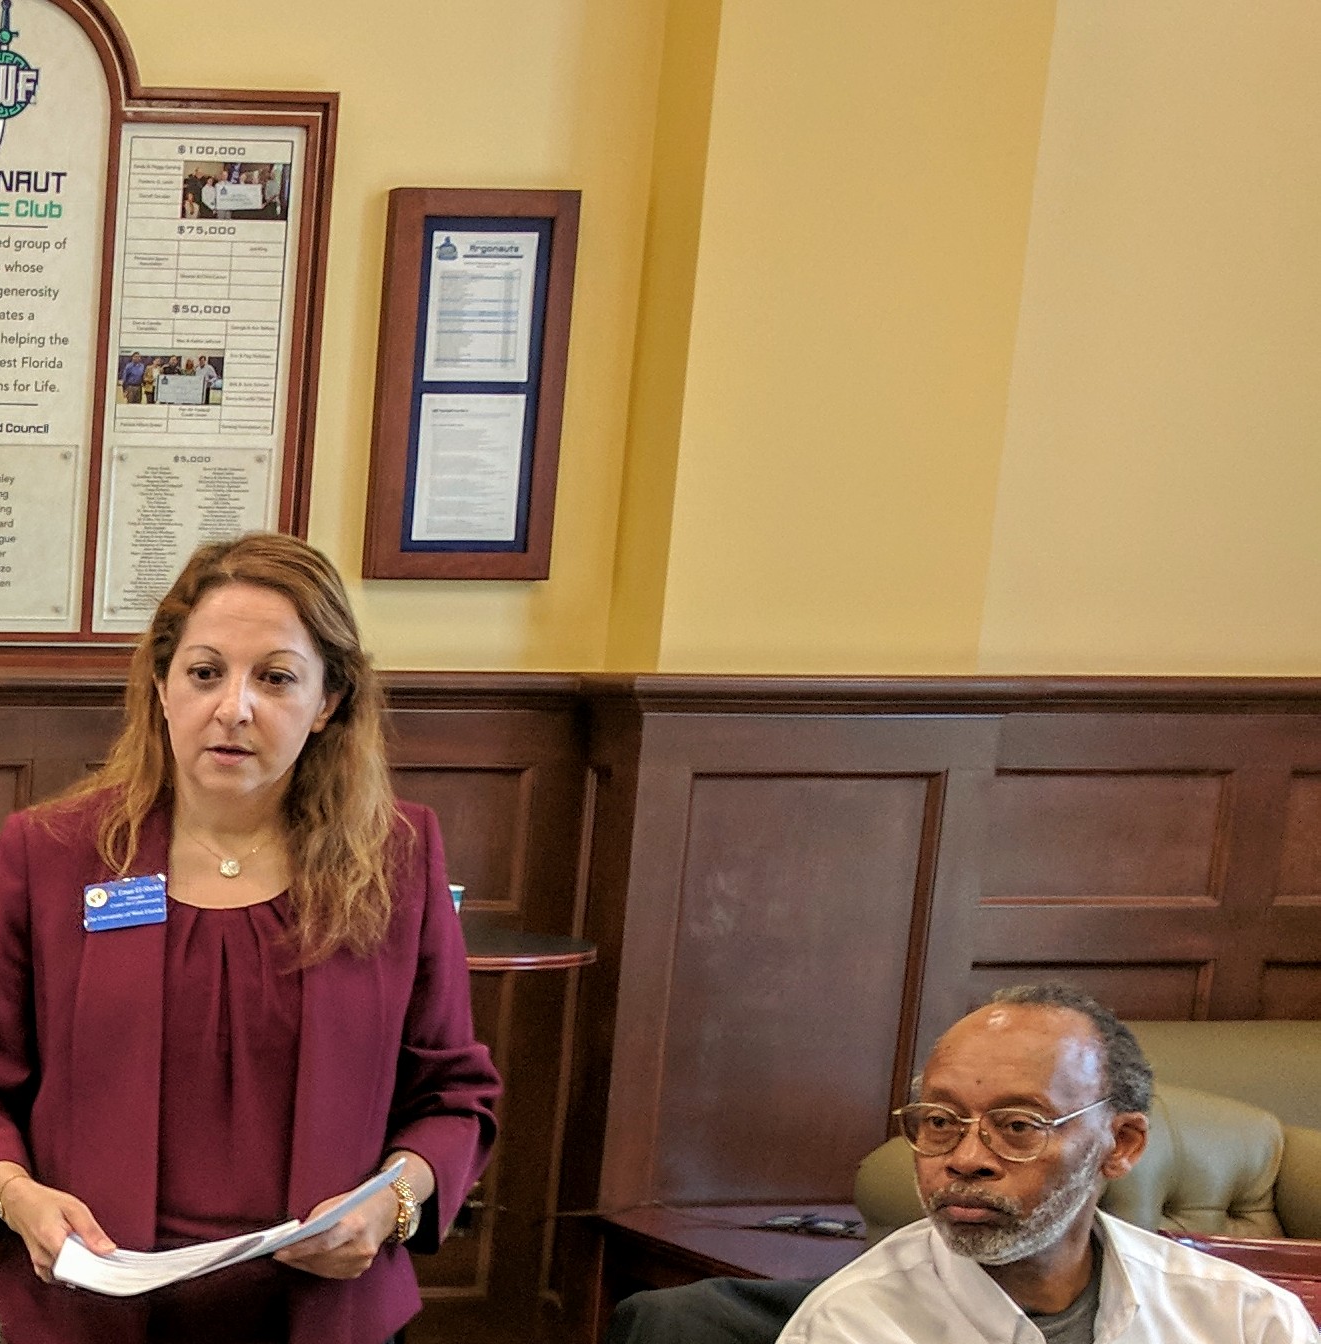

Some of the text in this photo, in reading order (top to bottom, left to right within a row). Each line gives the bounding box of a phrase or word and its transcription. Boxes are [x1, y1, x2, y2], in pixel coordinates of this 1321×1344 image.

[177, 144, 246, 156] $100,000
[15, 199, 62, 218] Club
[177, 225, 237, 236] $75,000
[14, 239, 51, 253] group
[54, 237, 67, 249] of
[5, 261, 44, 273] whose
[172, 304, 231, 315] $50,000
[28, 312, 35, 321] a
[0, 332, 46, 348] helping
[49, 333, 70, 346] the
[21, 356, 63, 369] Florida
[13, 379, 31, 392] for
[34, 380, 60, 393] Life.
[5, 423, 49, 434] Council
